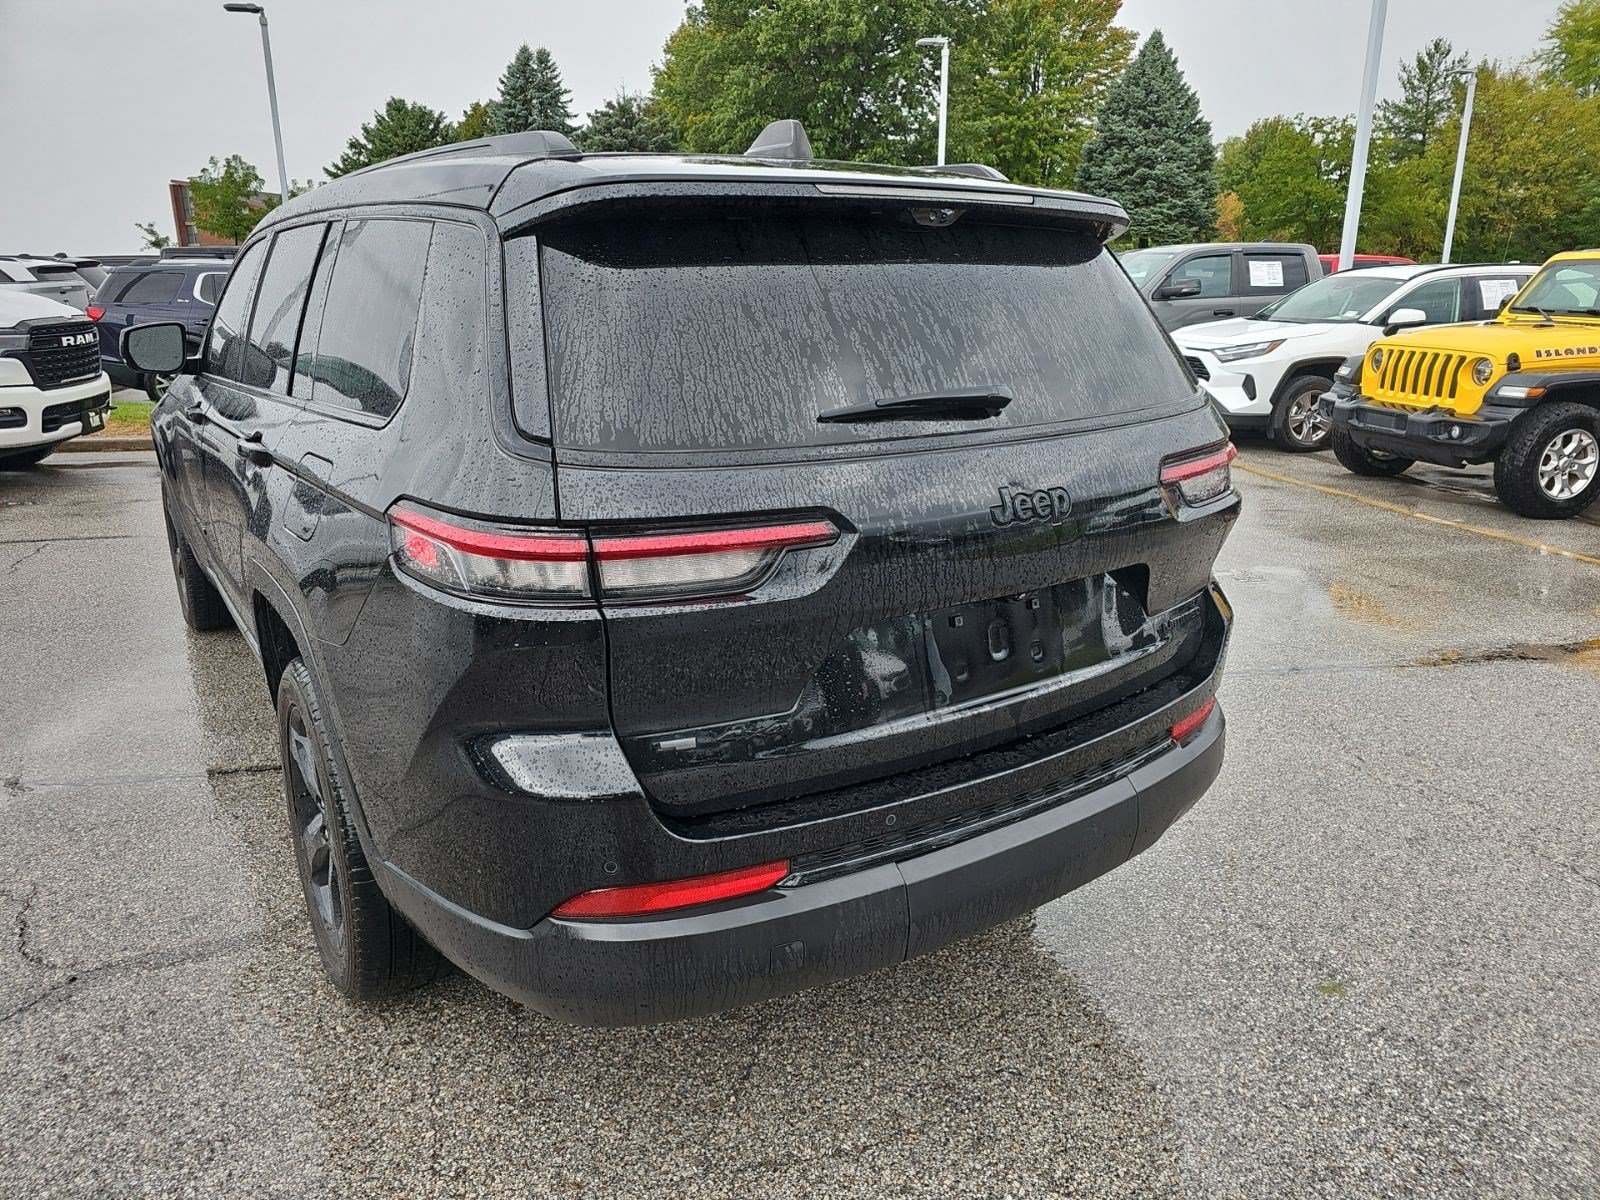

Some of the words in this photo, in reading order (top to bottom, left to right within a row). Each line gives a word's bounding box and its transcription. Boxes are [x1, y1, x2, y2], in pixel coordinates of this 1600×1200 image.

[61, 333, 94, 347] RAM
[1535, 346, 1600, 358] ISLAND
[989, 486, 1072, 527] Jeep
